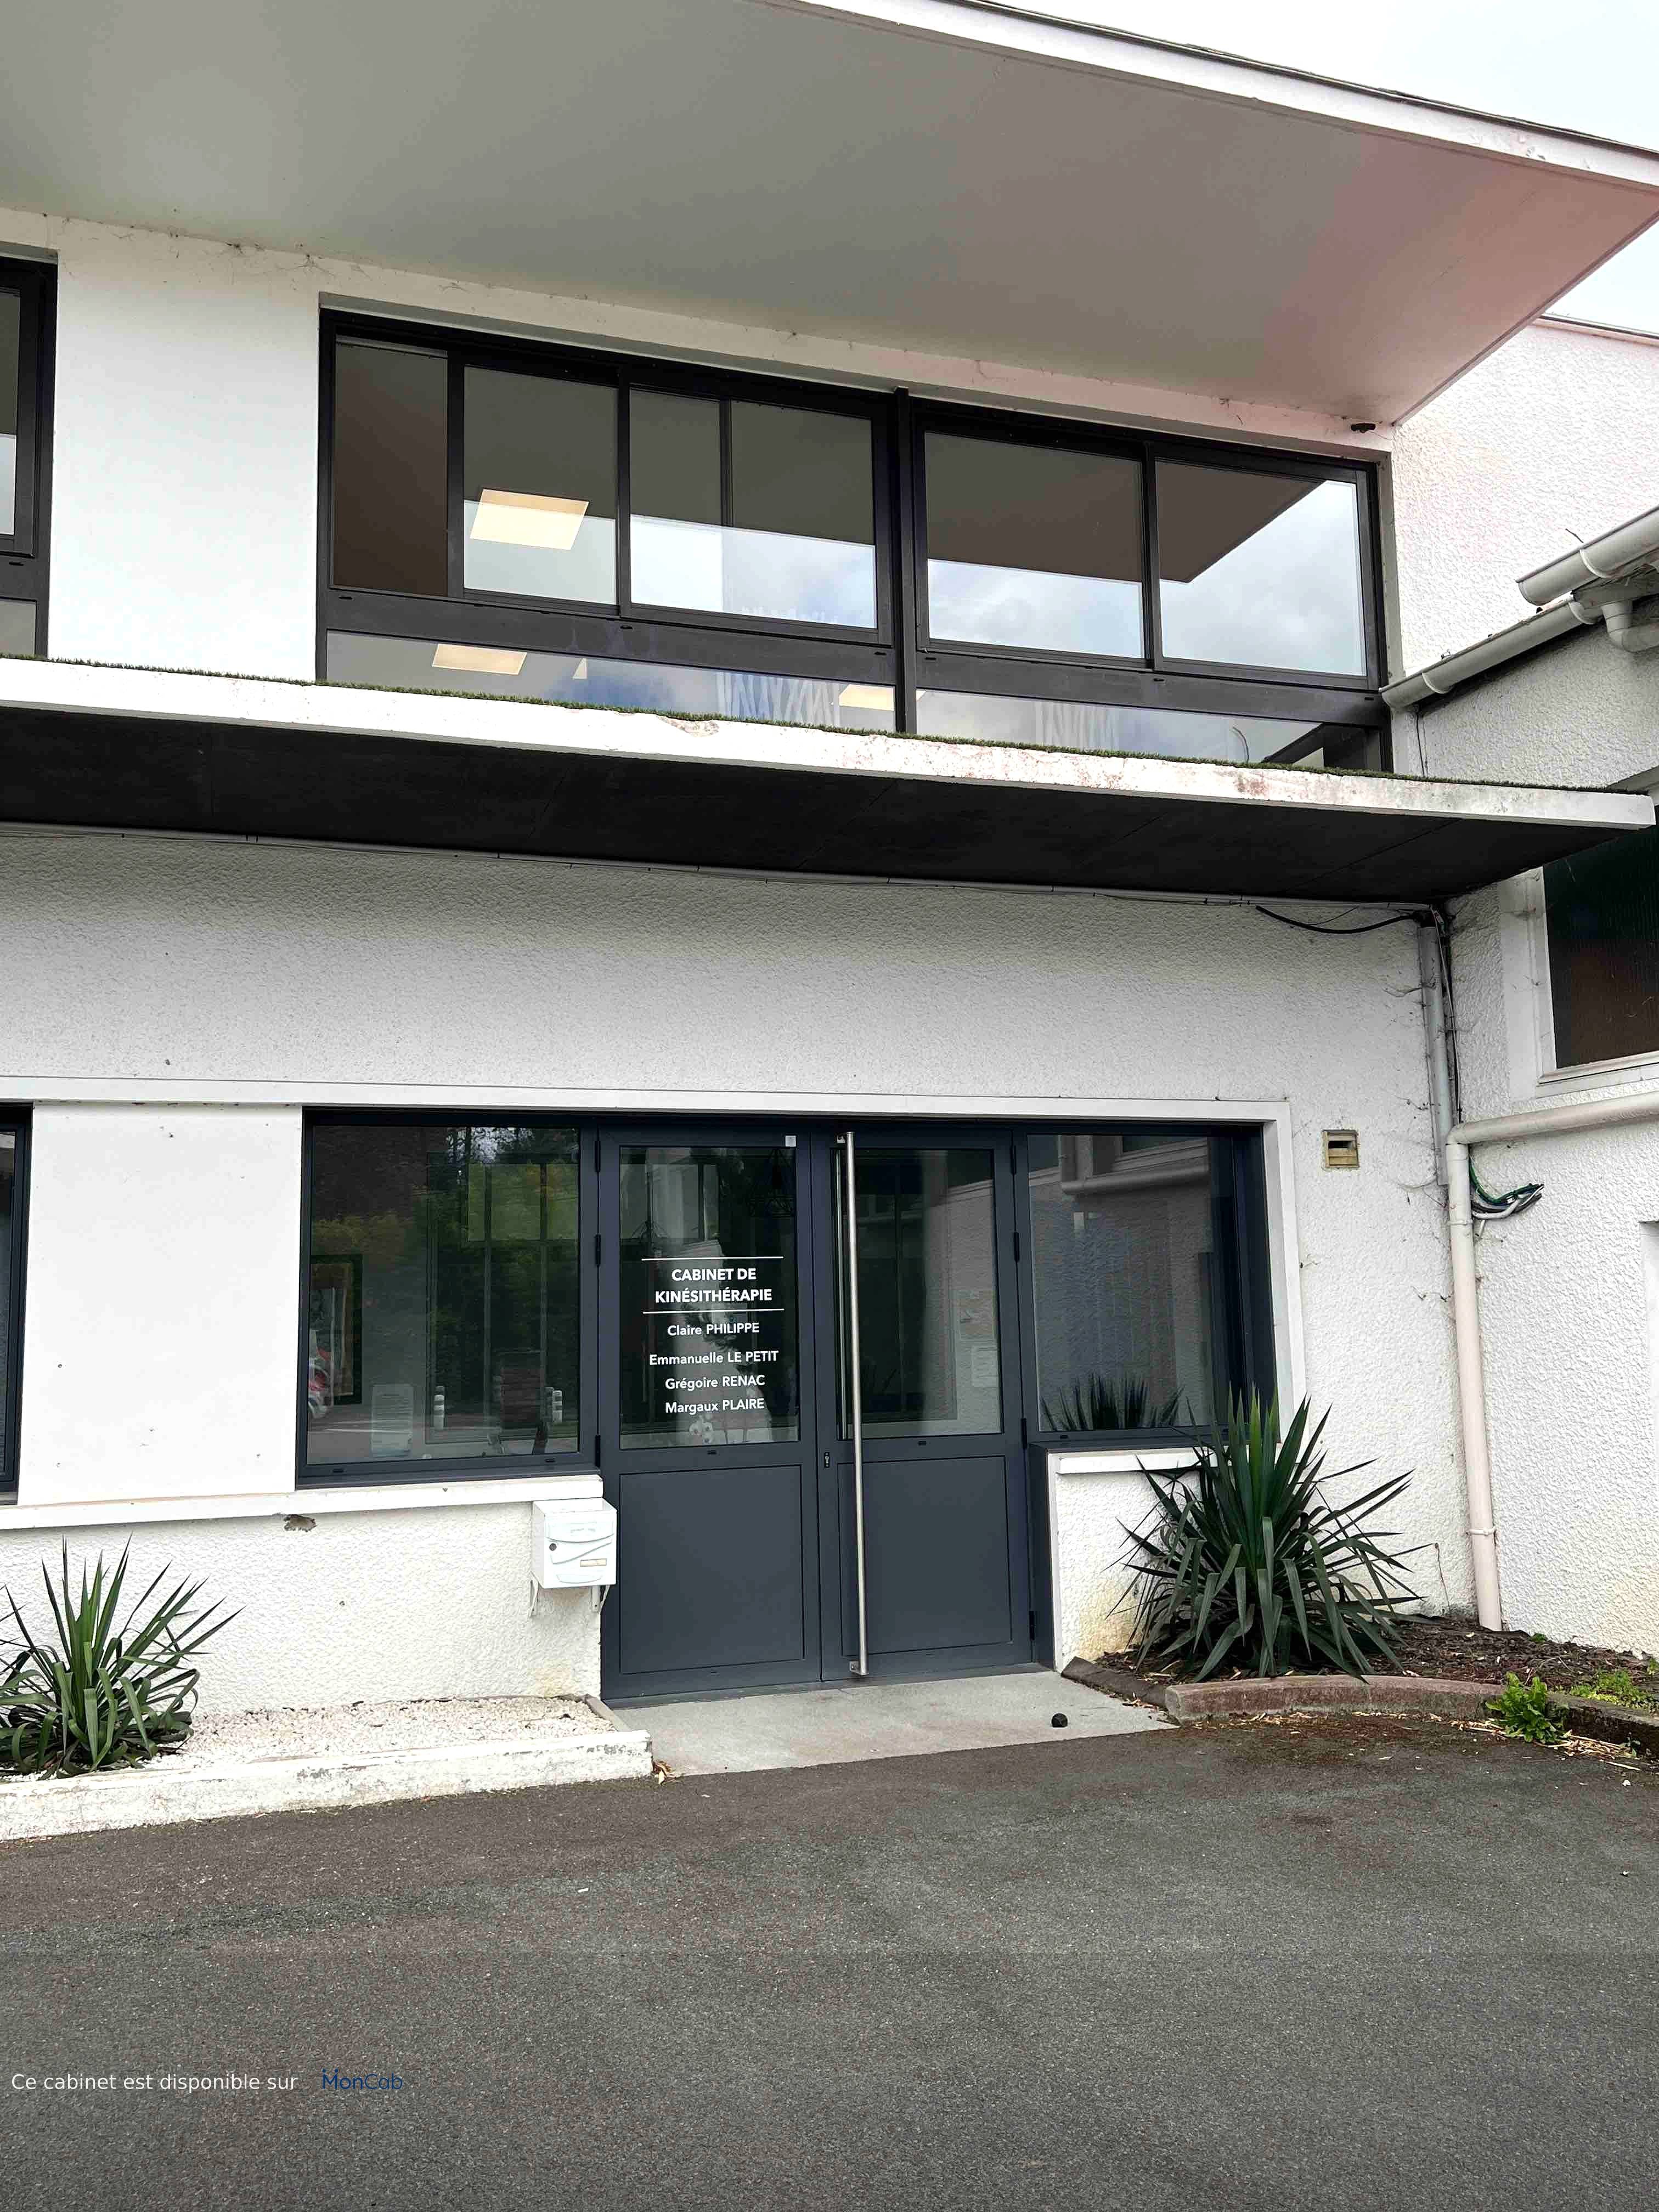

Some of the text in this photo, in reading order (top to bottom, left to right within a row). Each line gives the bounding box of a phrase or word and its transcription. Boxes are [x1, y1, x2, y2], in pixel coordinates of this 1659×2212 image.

[672, 1268, 757, 1281] CABINET DE
[655, 1287, 772, 1304] KINÉSITHÉRAPIE
[667, 1322, 760, 1336] Claire PHILIPPE
[649, 1350, 779, 1365] Emmanuelle LE PETIT
[665, 1374, 765, 1391] Grégoire RENAC
[665, 1398, 765, 1415] Margaux PLAIRE
